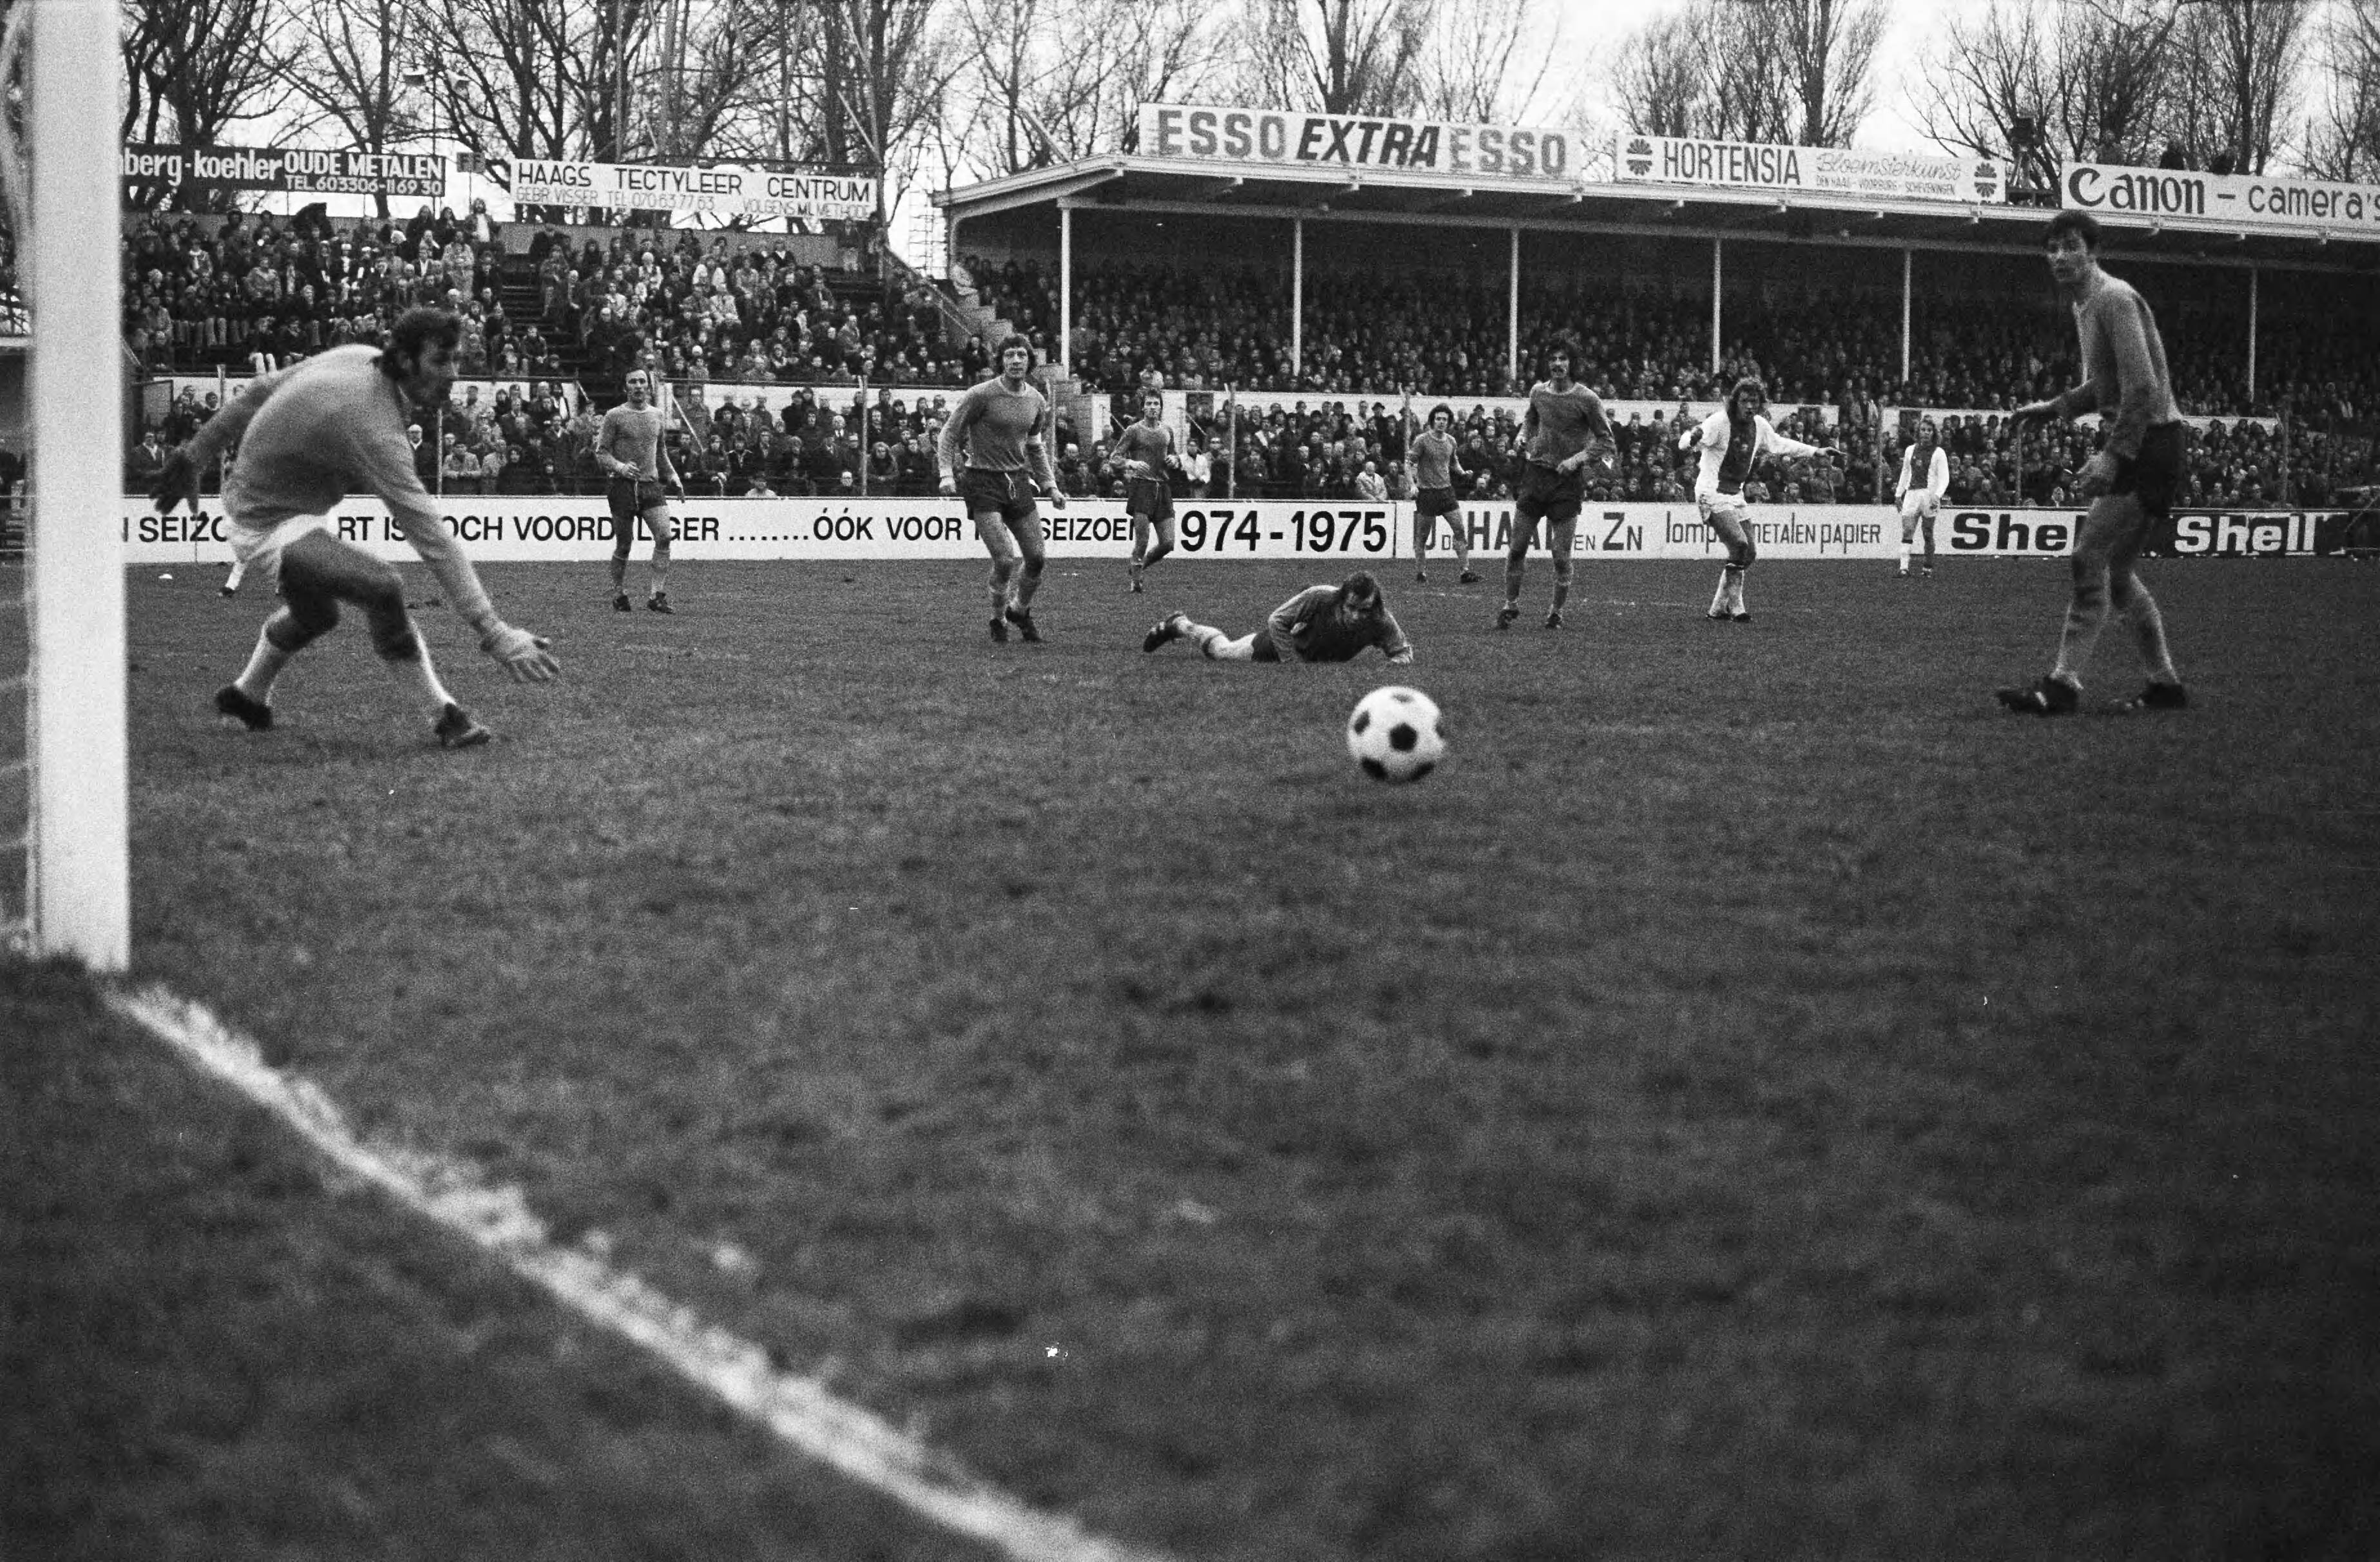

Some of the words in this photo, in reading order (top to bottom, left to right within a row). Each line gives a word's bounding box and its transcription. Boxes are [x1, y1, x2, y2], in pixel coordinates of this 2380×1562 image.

[1159, 110, 1285, 159] ESSO
[1296, 117, 1440, 168] EXTRA
[1450, 128, 1567, 176] ESSO
[1663, 140, 1801, 186] HORTENSIA
[284, 150, 342, 175] OUDE
[347, 153, 443, 180] METALEN
[518, 162, 592, 188] HAAGS
[614, 167, 742, 195] TECTYLEER
[767, 177, 871, 203] CENTRUM
[554, 188, 598, 205] VISSER
[2068, 167, 2206, 215] Canon
[886, 516, 962, 541] VOOR
[1180, 510, 1387, 553] 974-1975
[1951, 512, 2088, 552] She
[2174, 514, 2317, 553] Shell
